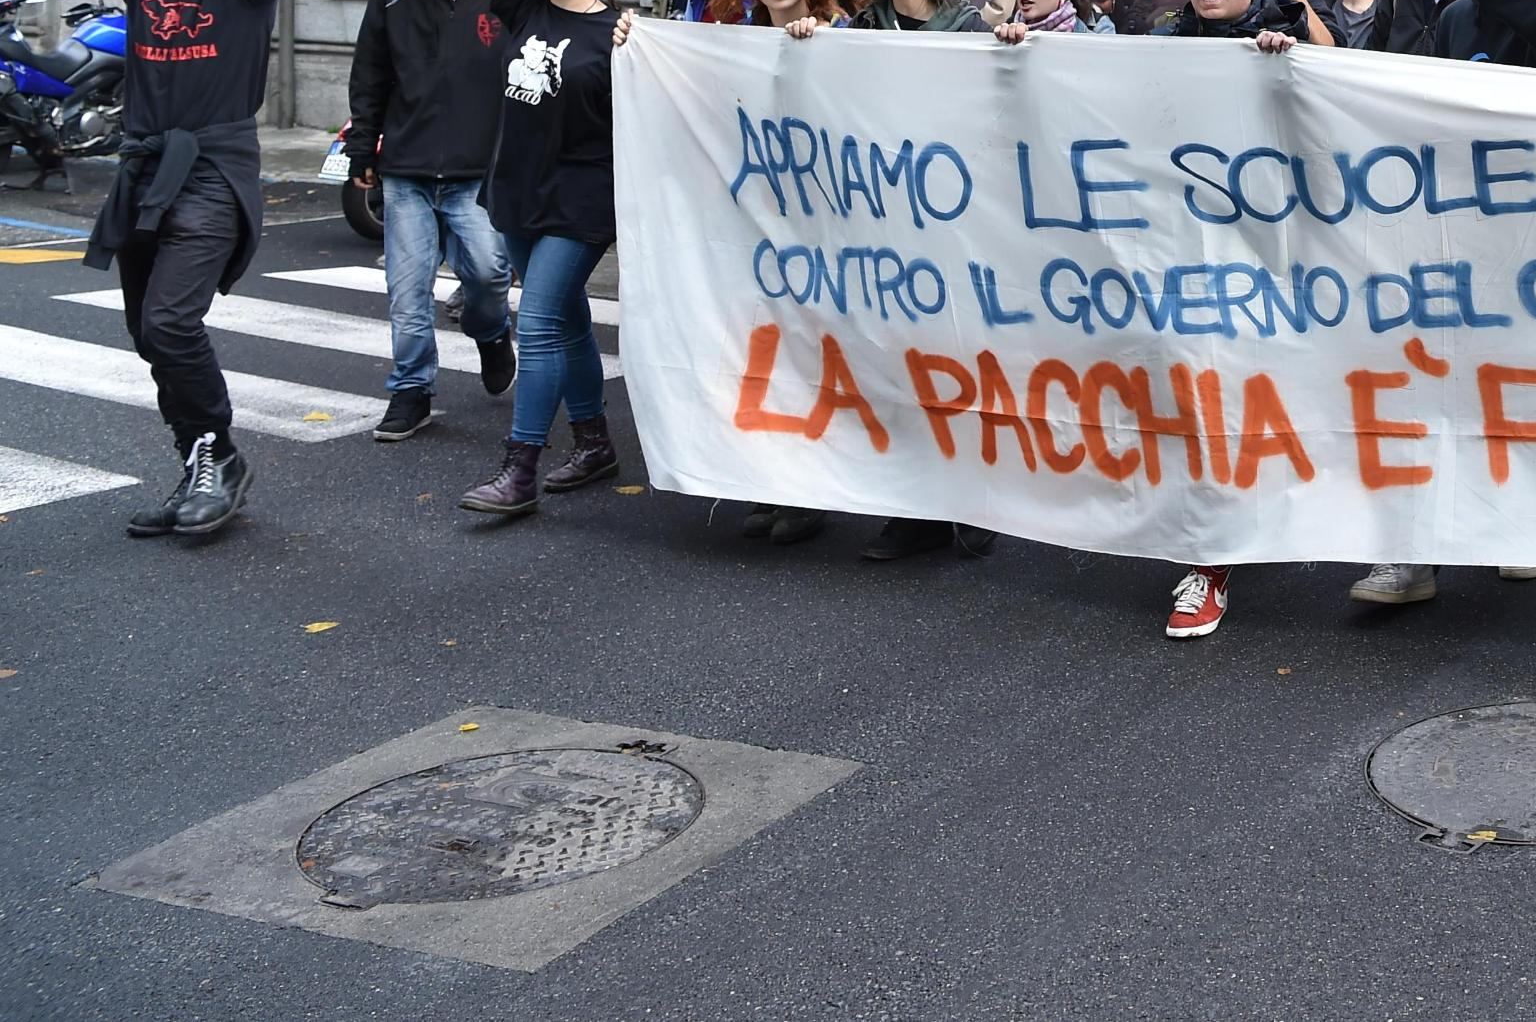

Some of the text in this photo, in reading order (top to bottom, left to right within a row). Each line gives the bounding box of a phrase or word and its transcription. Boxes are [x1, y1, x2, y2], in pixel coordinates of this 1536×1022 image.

[505, 85, 543, 105] acab
[730, 105, 973, 229] APRIAMO
[1017, 138, 1152, 232] LE
[752, 238, 947, 324] CONTRO
[967, 260, 1036, 327] IL
[1039, 257, 1350, 339] GOVERNO
[1364, 261, 1515, 335] DEL
[733, 322, 891, 454] LA
[904, 347, 1316, 489] PACCHIA
[1344, 337, 1451, 491] È
